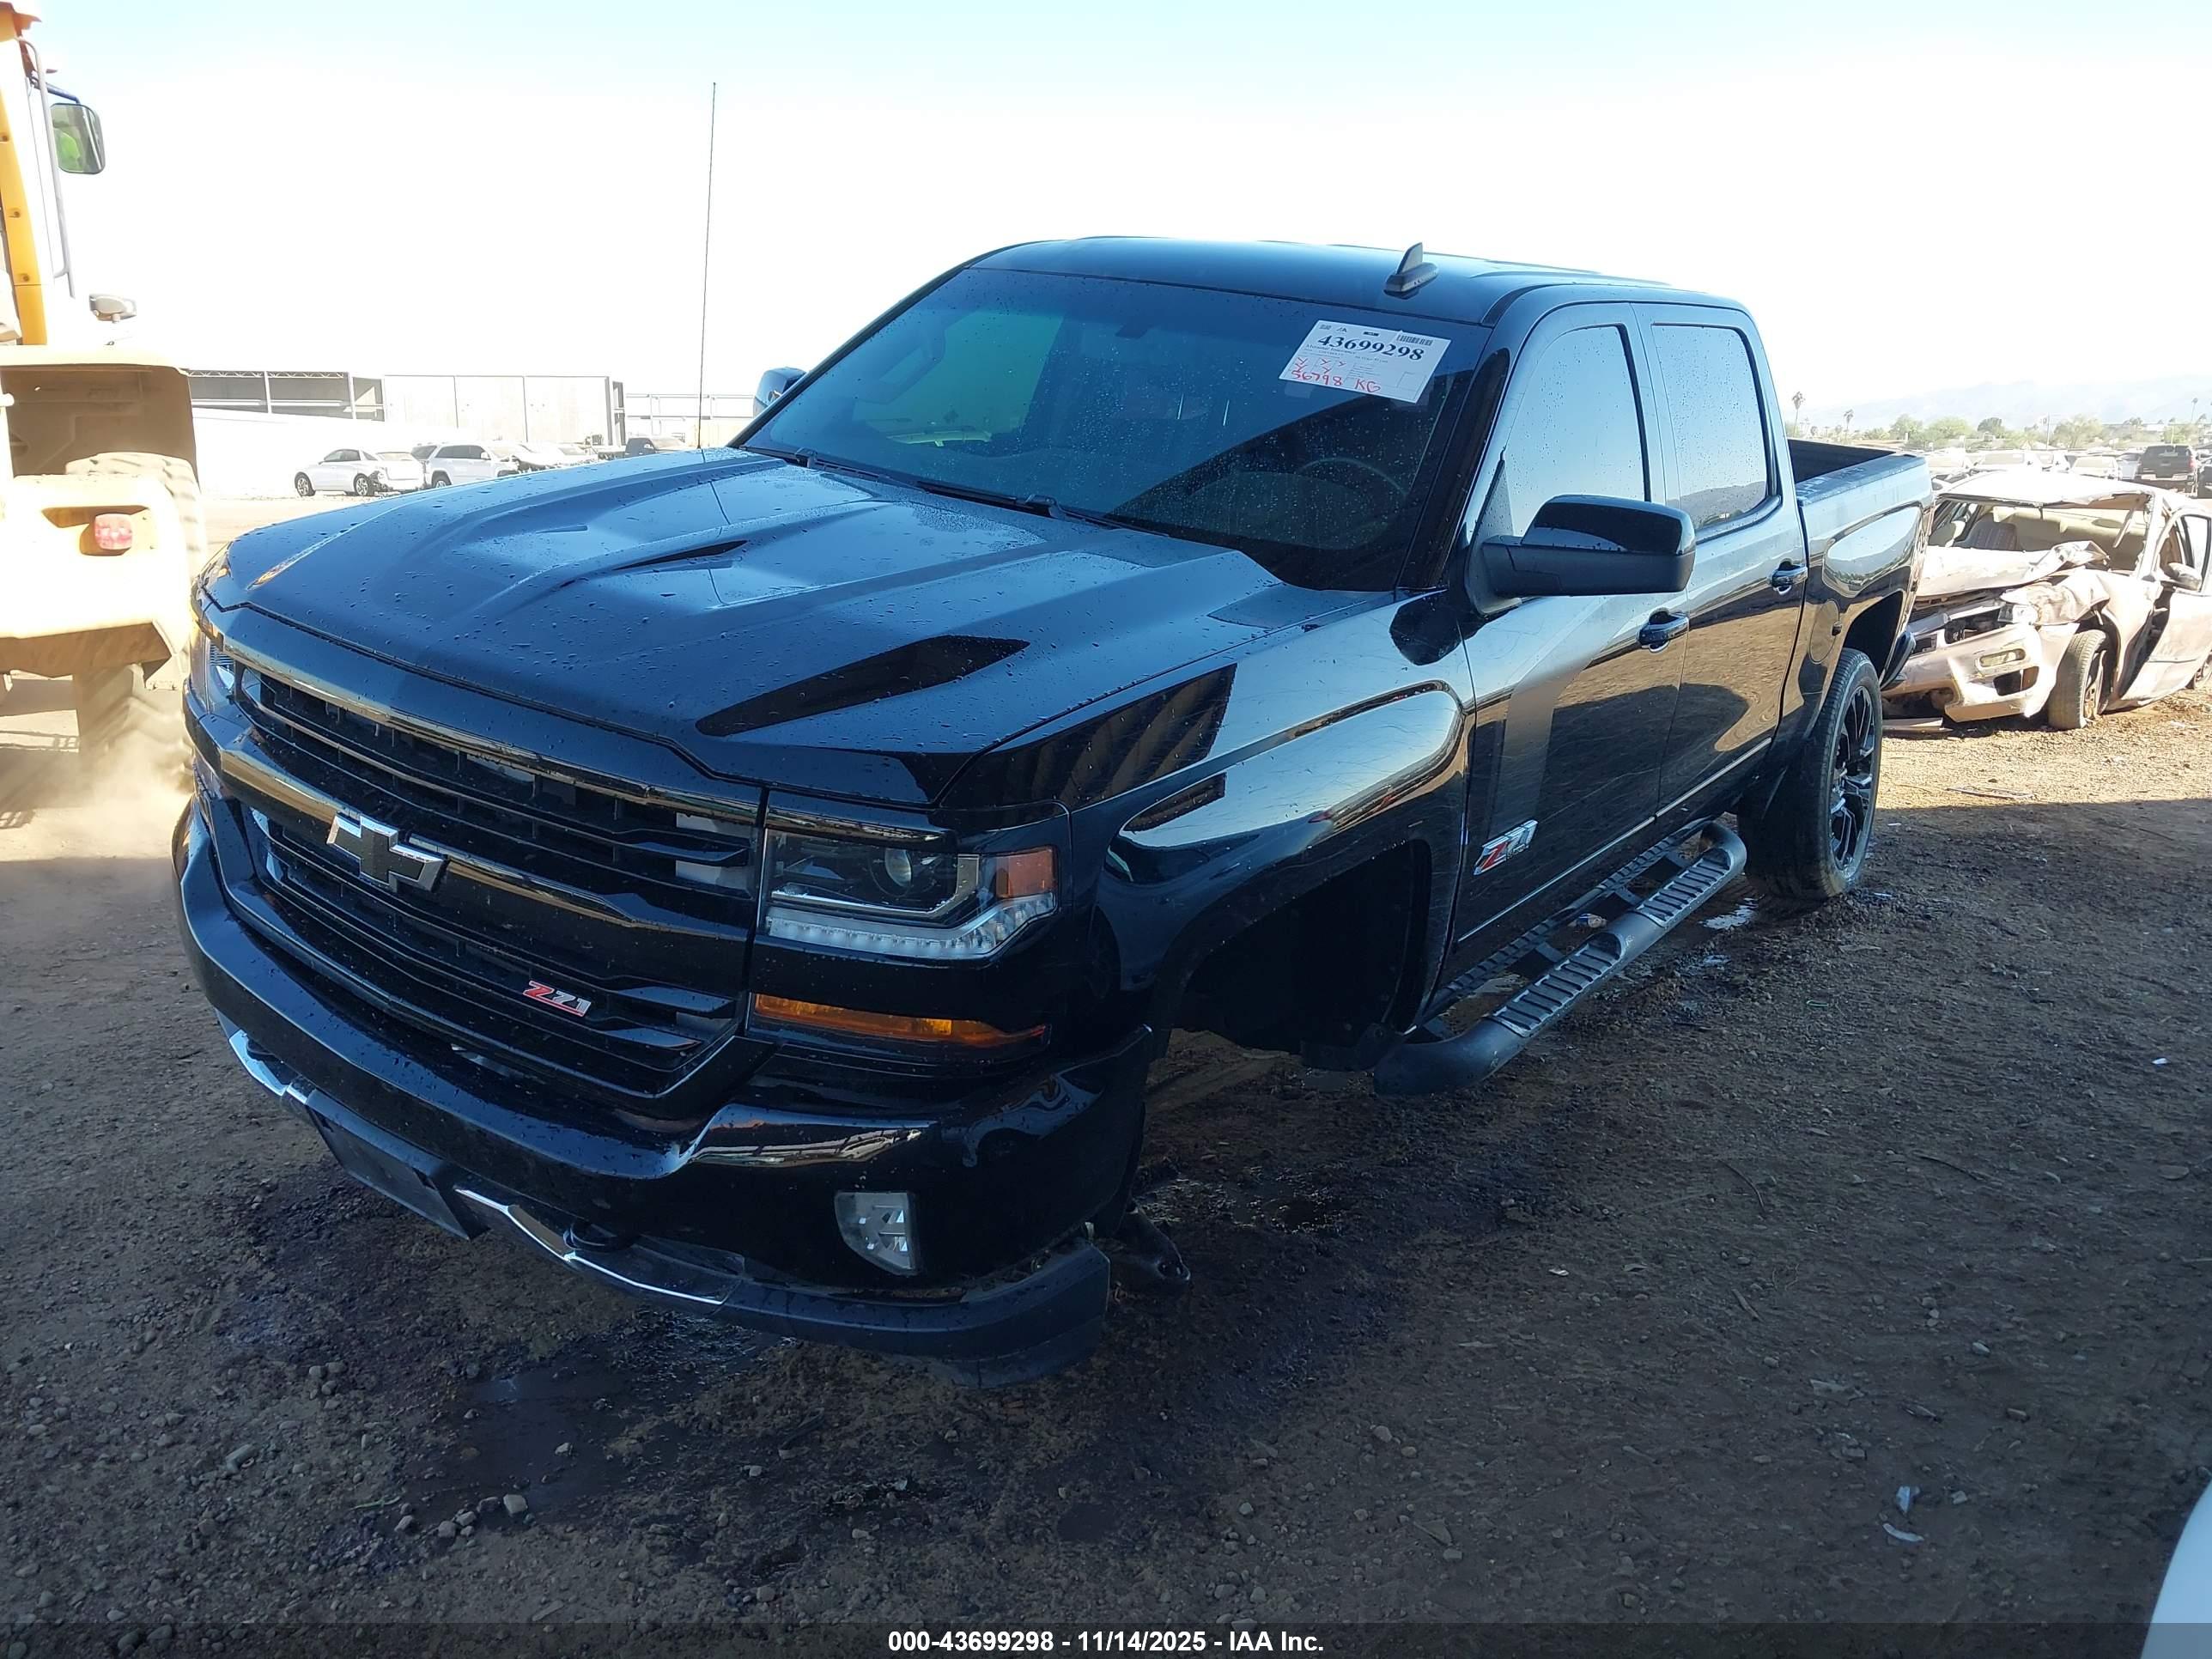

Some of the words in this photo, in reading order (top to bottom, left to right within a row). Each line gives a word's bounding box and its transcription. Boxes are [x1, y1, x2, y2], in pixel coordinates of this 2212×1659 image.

[1317, 335, 1425, 361] 43699298
[1473, 819, 1539, 876] Z71
[522, 980, 592, 1018] Z71
